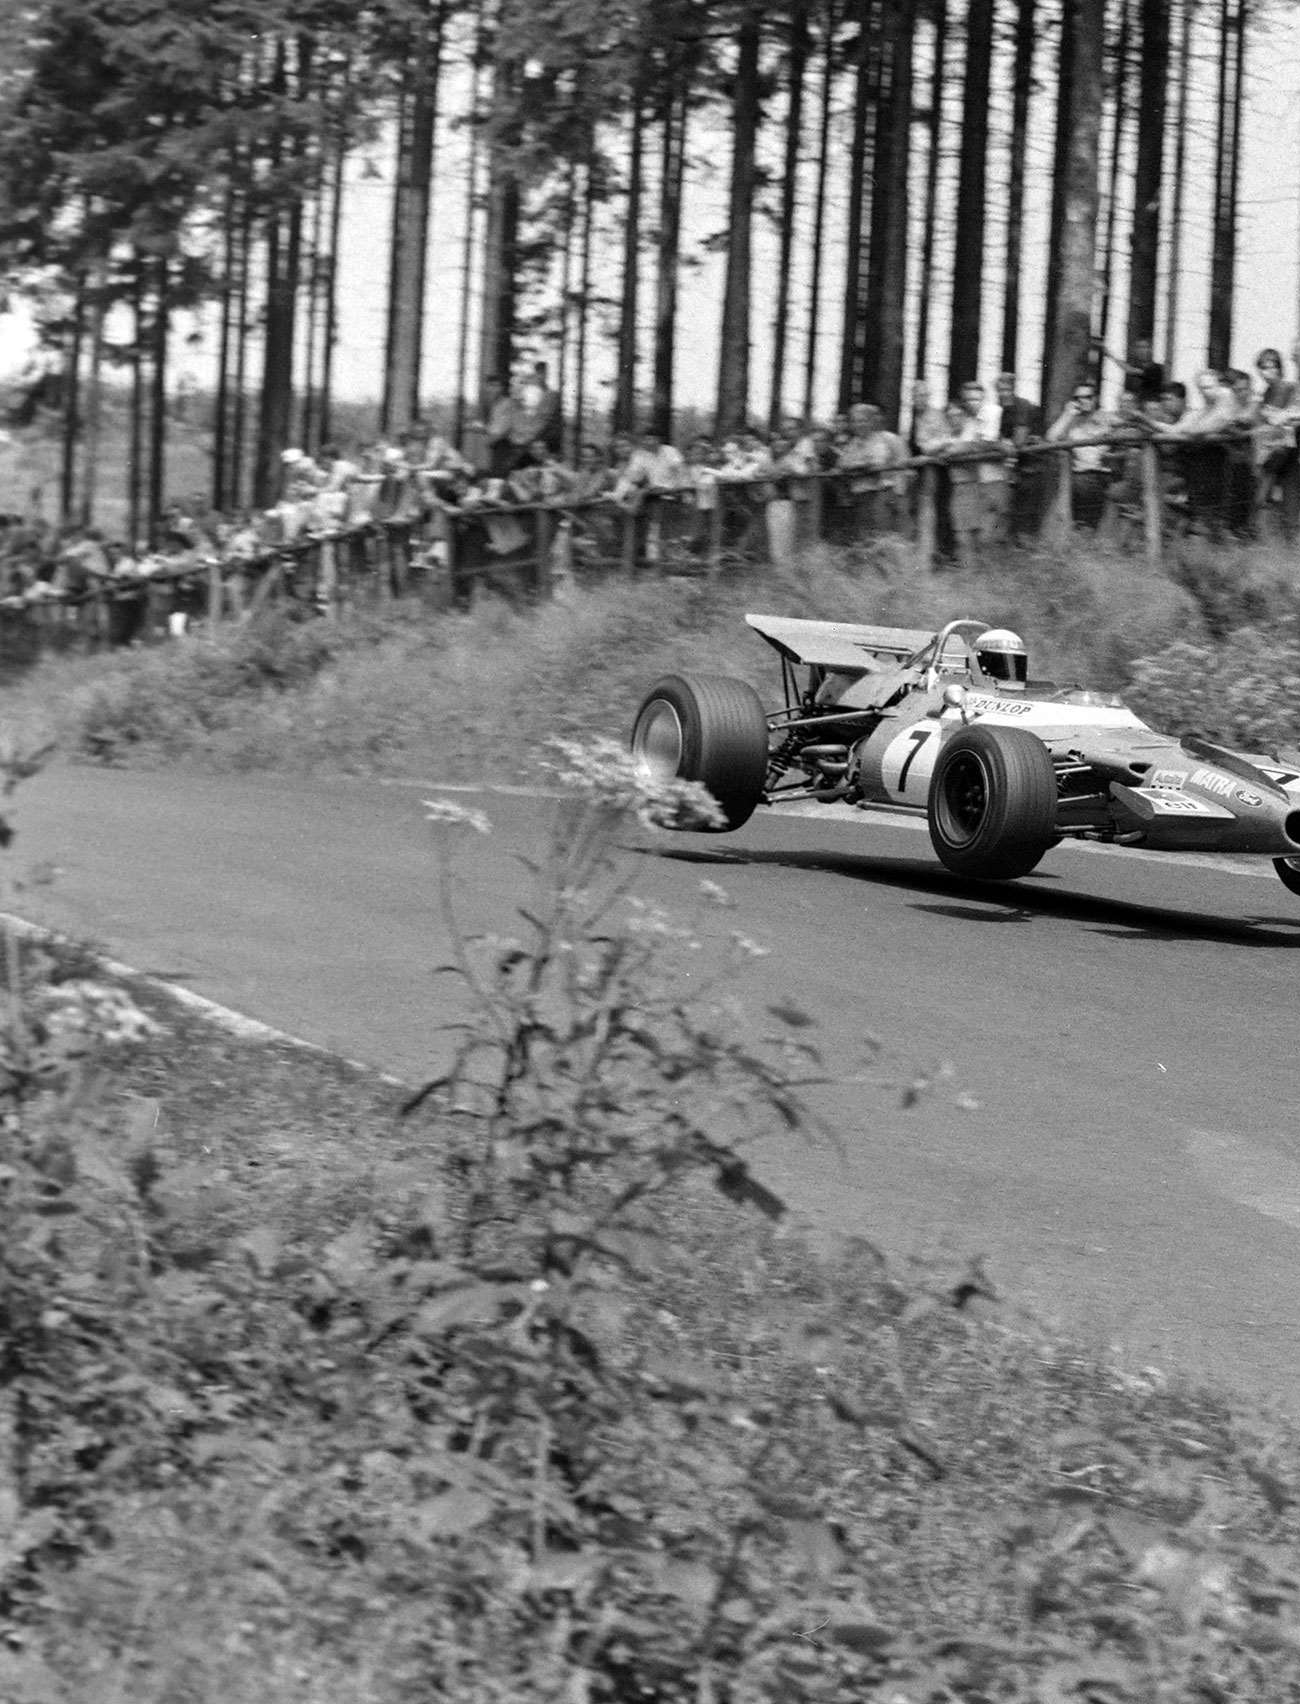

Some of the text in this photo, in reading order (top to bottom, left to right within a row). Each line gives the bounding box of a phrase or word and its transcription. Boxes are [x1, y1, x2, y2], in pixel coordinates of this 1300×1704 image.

[975, 699, 1032, 715] DUNLOP
[898, 730, 932, 793] 7
[1190, 768, 1238, 798] MATRA
